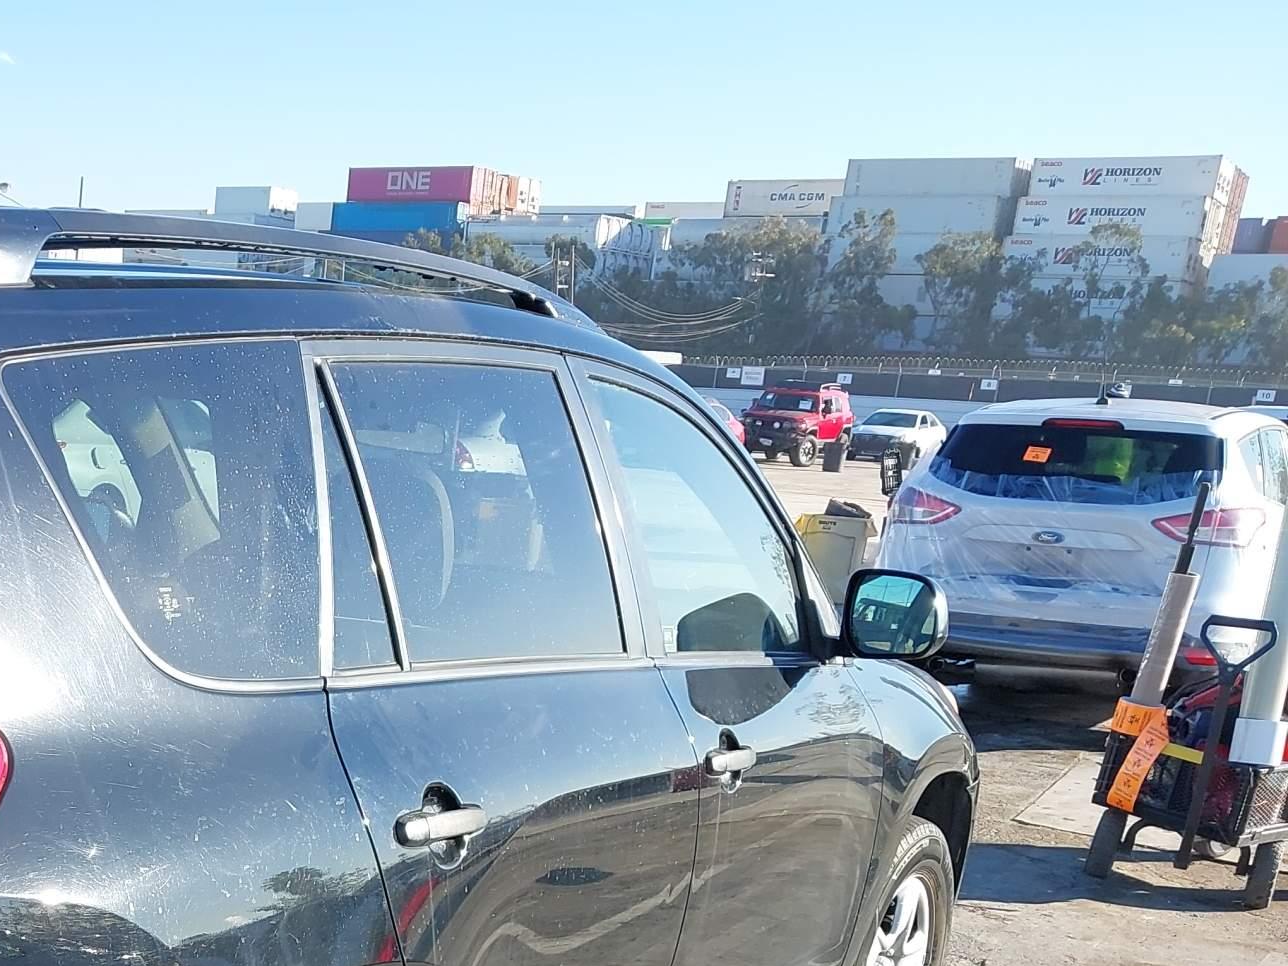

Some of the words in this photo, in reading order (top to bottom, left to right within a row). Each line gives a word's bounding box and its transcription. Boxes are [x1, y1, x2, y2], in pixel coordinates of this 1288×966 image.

[1104, 168, 1163, 176] HORIZON
[387, 171, 431, 190] ONE
[770, 192, 796, 202] CMA
[799, 192, 825, 201] CGM
[1089, 207, 1147, 216] HORIZON
[1079, 247, 1133, 257] ORIZON
[1262, 392, 1271, 400] 10
